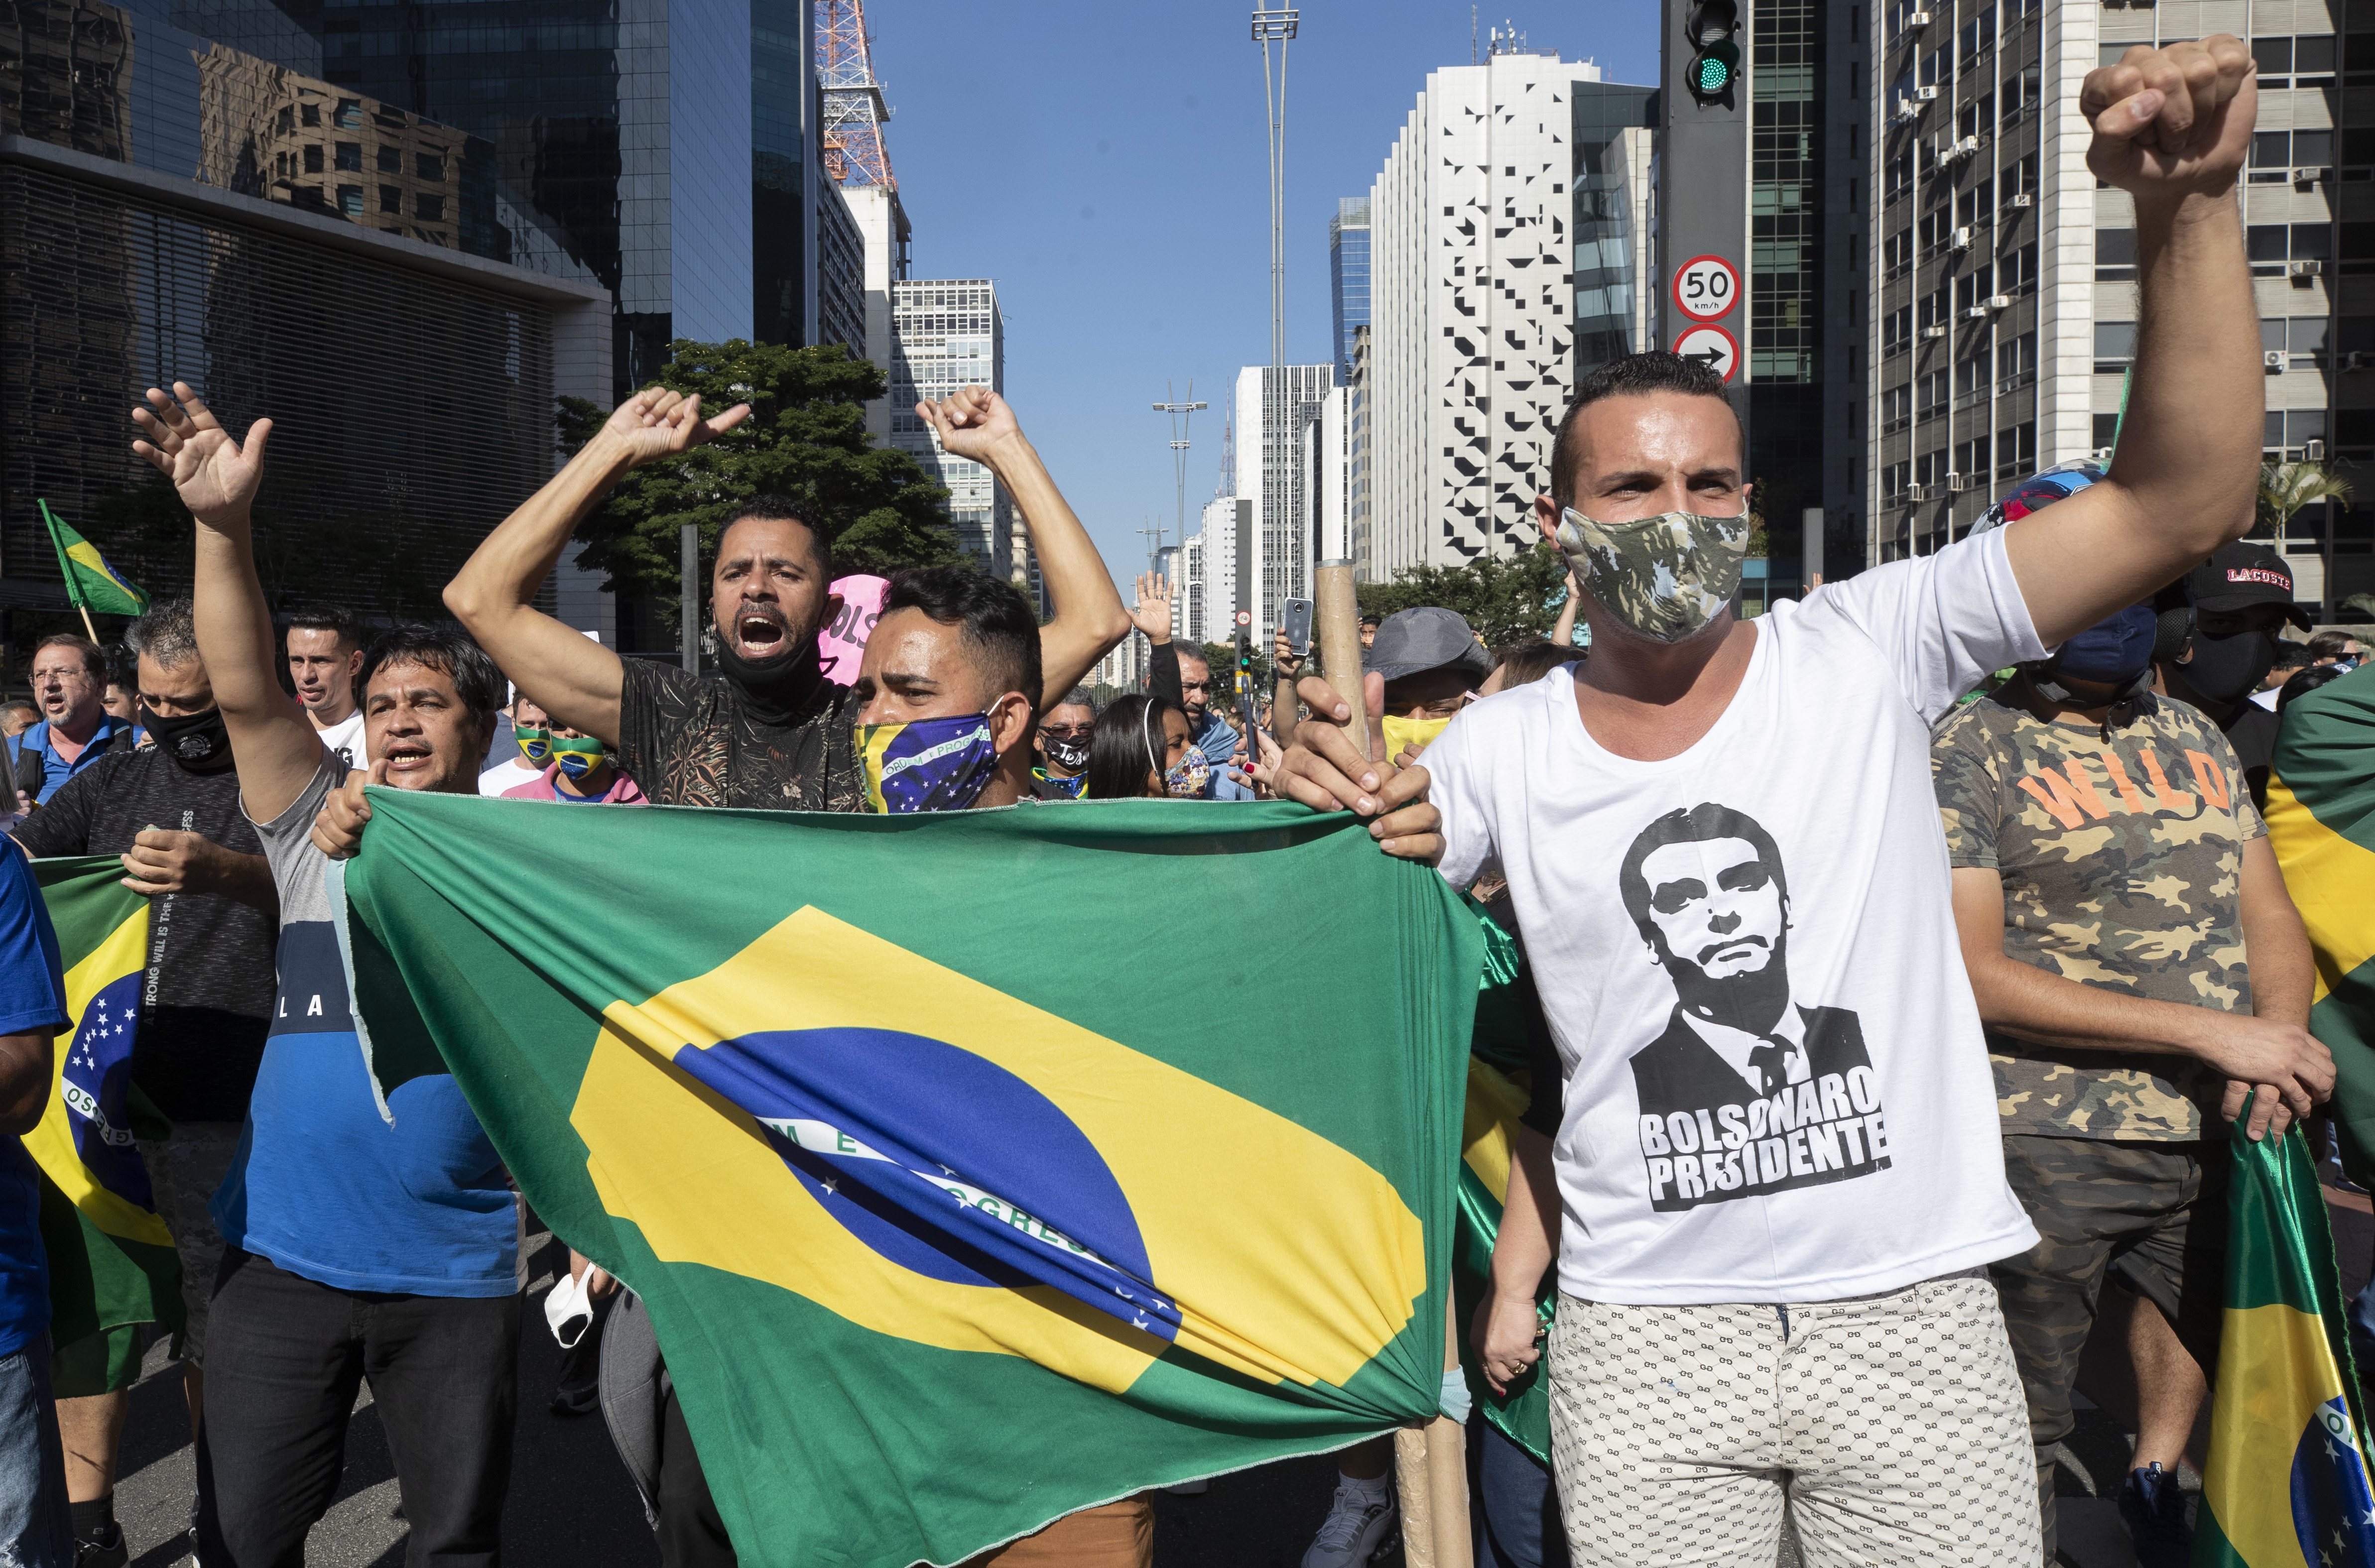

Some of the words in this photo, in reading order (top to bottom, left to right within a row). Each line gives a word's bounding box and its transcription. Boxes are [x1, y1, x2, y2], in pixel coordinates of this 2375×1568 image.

[1686, 271, 1728, 298] 50
[2228, 569, 2290, 592] LACOSTE
[886, 756, 923, 775] ORDEM
[2017, 749, 2229, 830] WILD
[159, 902, 172, 923] THE
[157, 926, 168, 936] IS
[152, 939, 166, 963] WILL
[144, 966, 160, 1014] STRONG
[143, 1017, 154, 1026] A
[1639, 1066, 1880, 1156] BOLSONARO
[1647, 1112, 1889, 1201] PRESIDENTE
